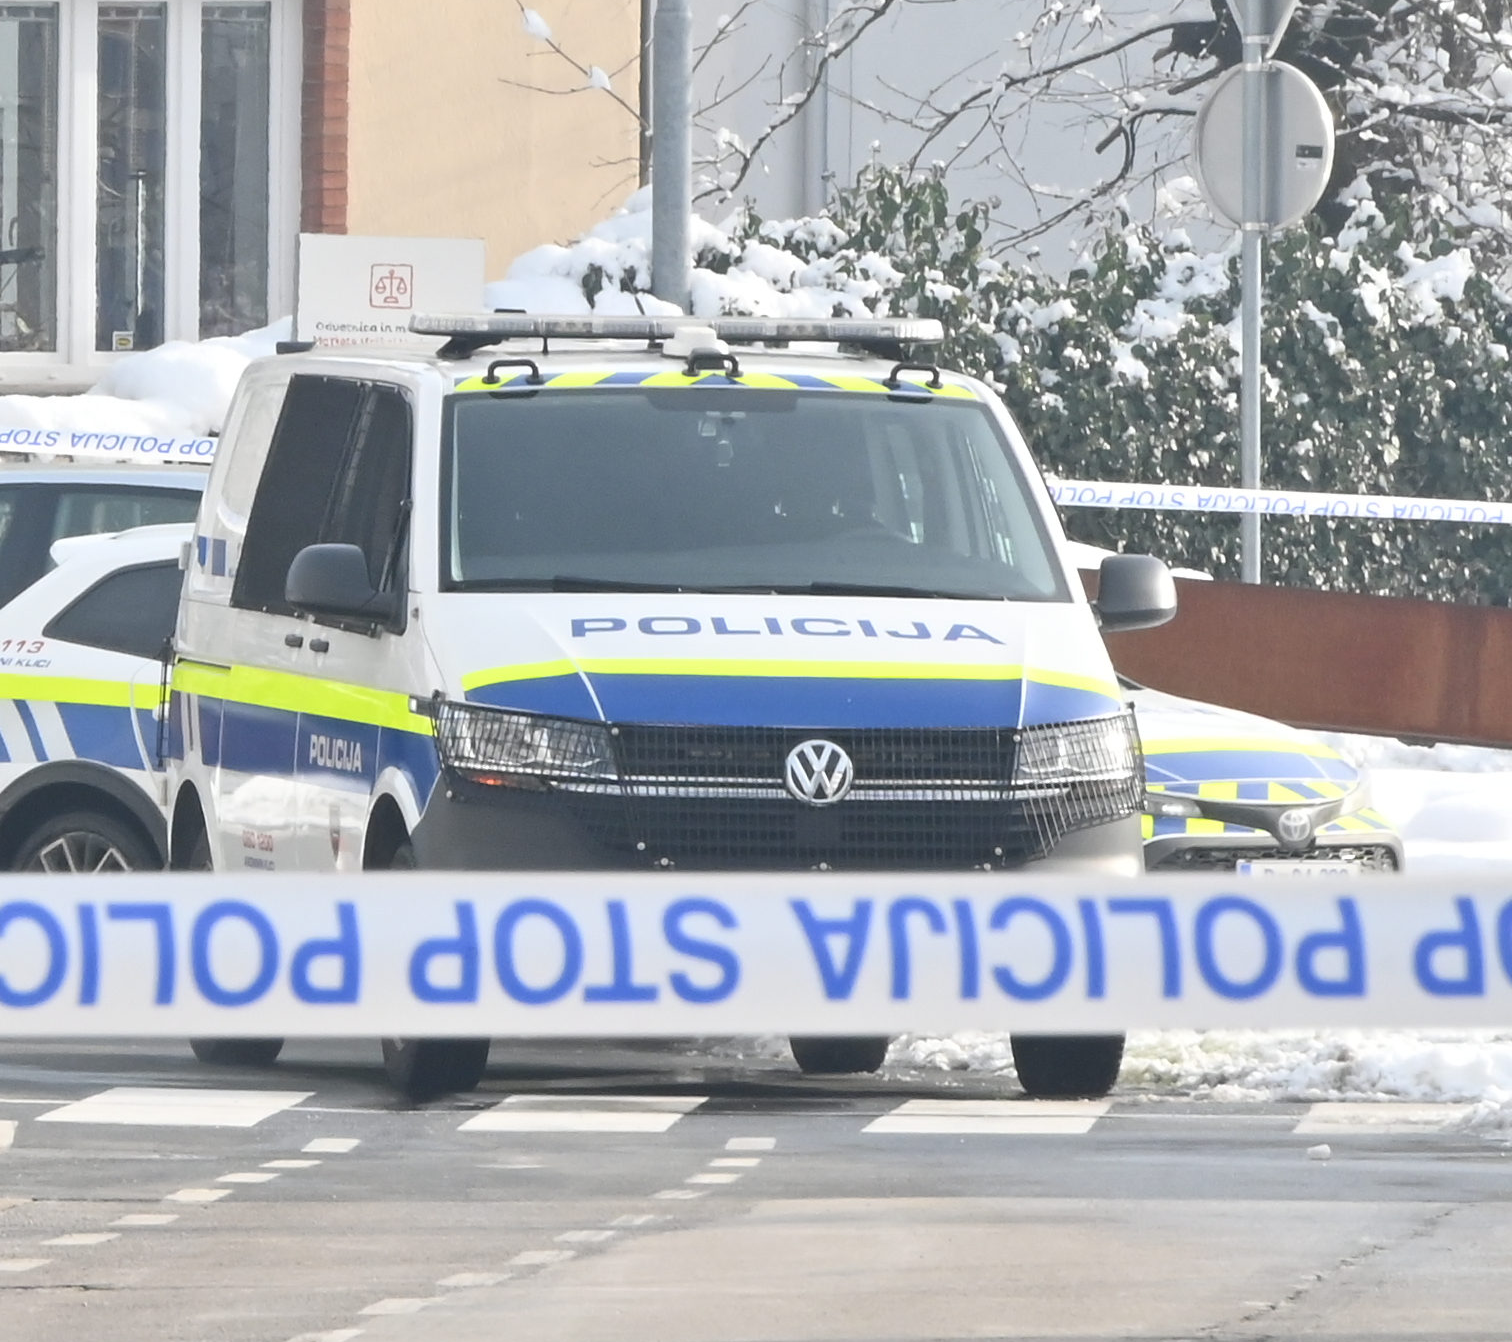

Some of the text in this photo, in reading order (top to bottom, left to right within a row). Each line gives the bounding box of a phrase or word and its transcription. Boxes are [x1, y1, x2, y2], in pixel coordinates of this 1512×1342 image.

[71, 433, 175, 454] POLICIJA
[1, 639, 45, 654] 113
[571, 616, 1007, 646] POLICIJA
[309, 733, 363, 773] POLICIJA
[409, 898, 742, 1007] STOP
[790, 897, 1368, 1003] POLICIJA
